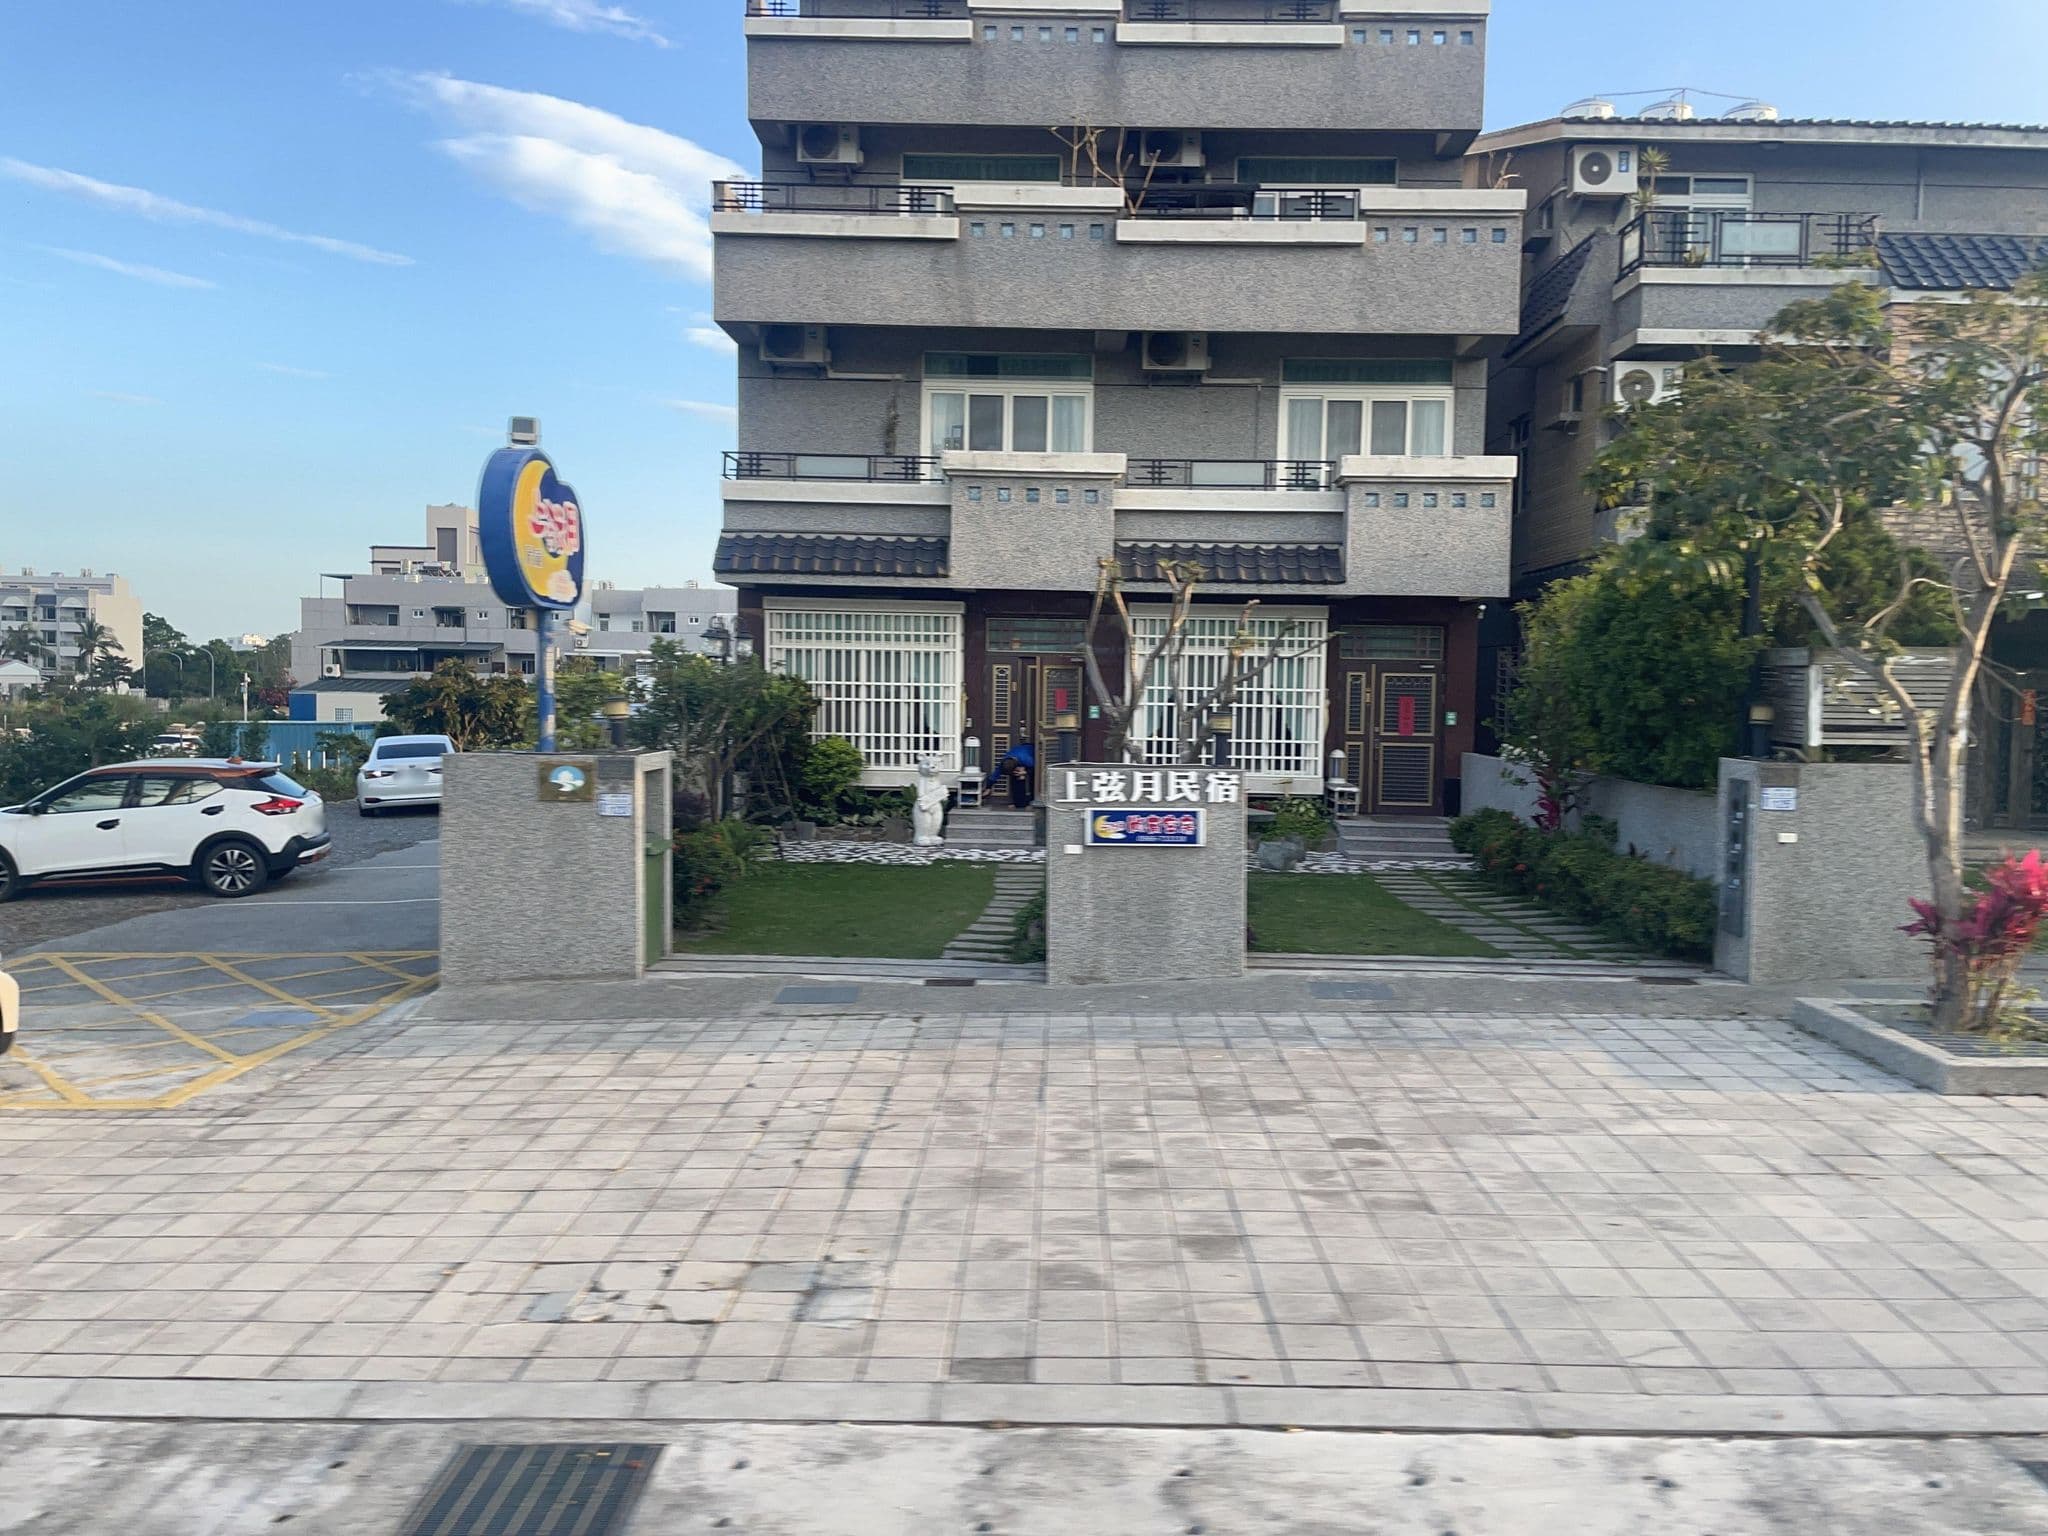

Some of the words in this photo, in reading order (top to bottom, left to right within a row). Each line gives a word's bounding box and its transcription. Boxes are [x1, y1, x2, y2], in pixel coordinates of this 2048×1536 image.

[1056, 771, 1240, 803] 上弦月民宿
